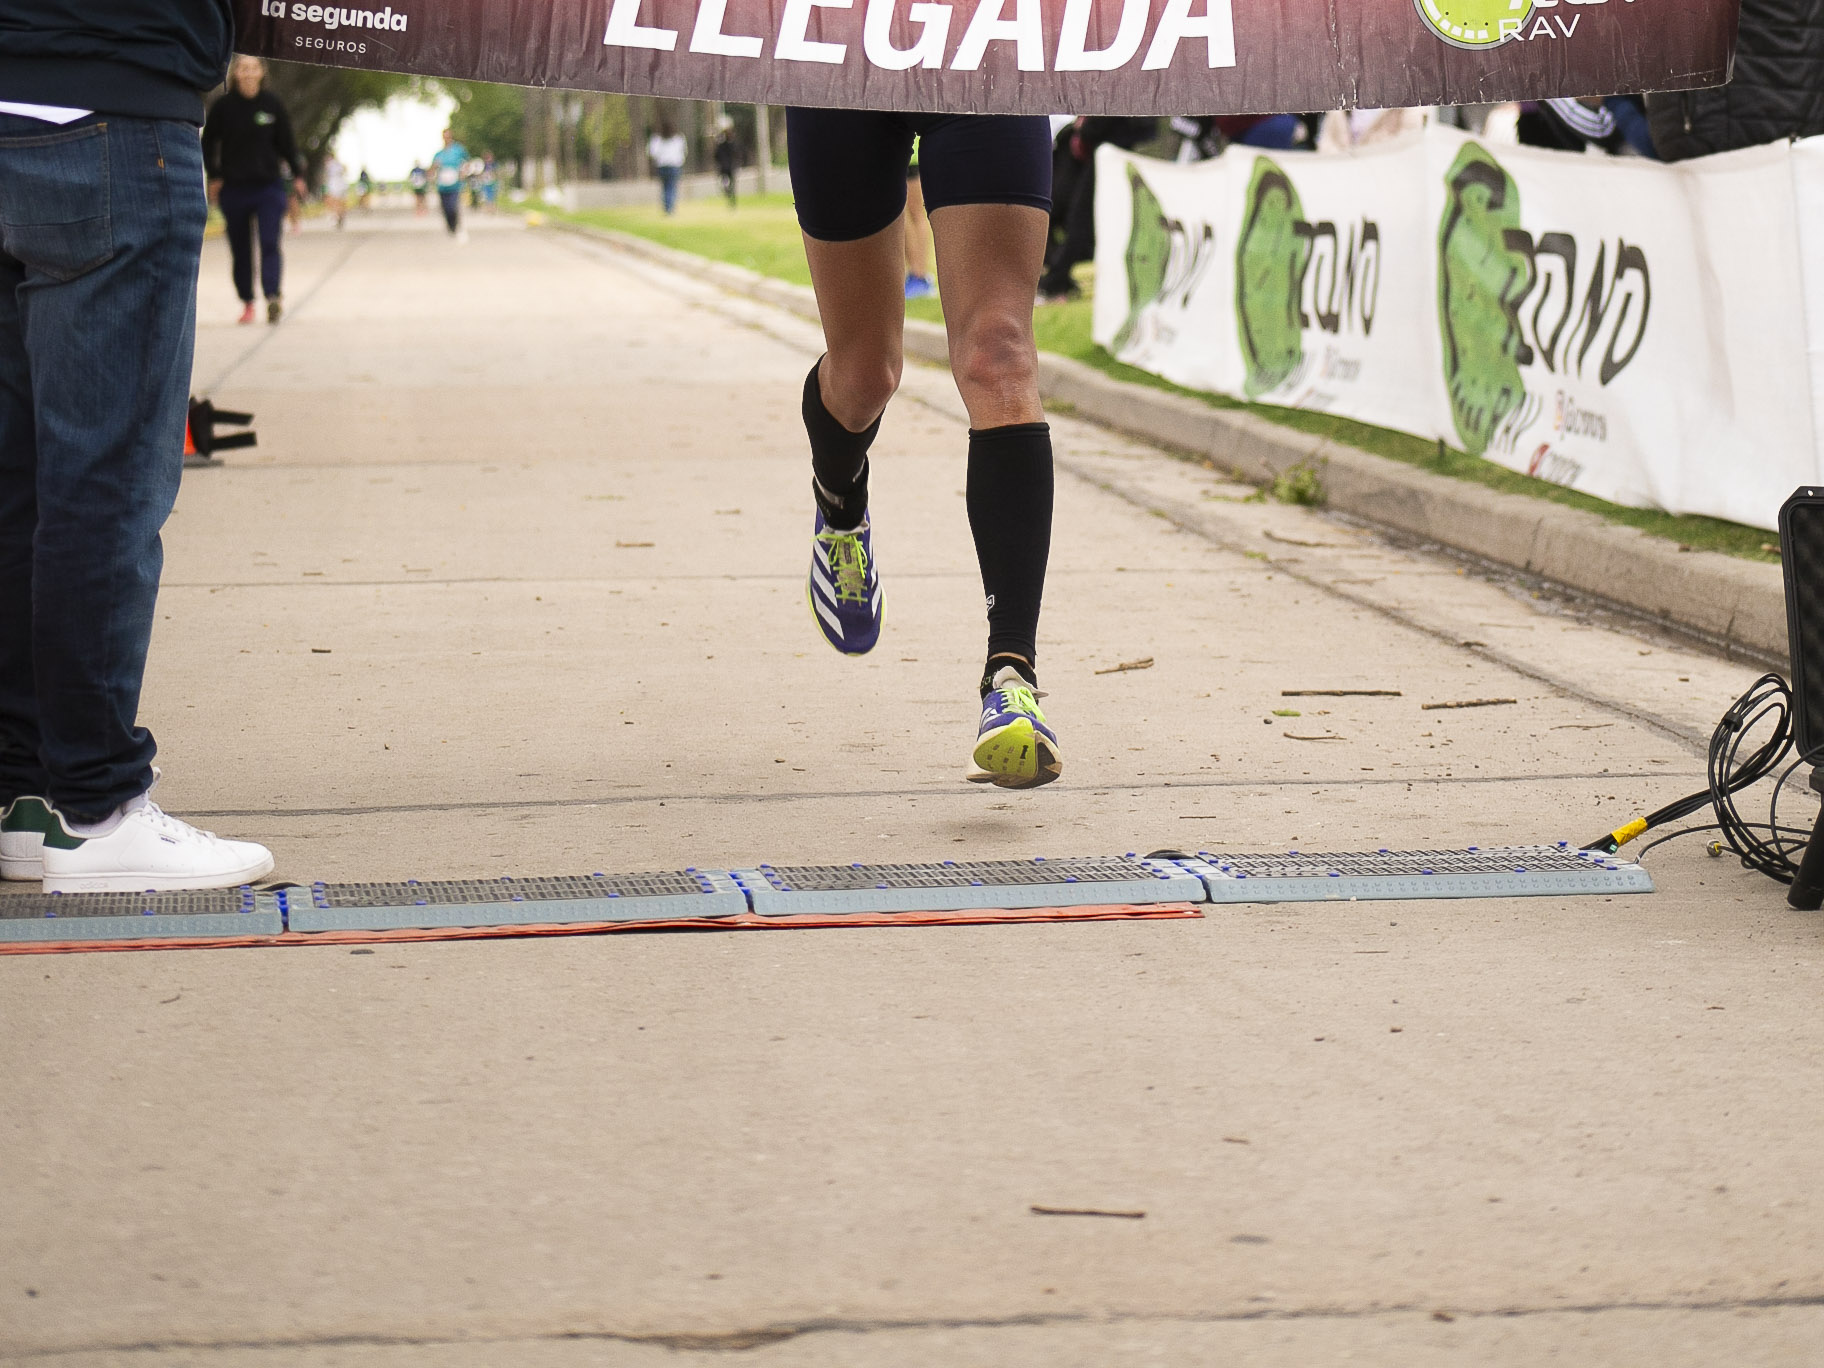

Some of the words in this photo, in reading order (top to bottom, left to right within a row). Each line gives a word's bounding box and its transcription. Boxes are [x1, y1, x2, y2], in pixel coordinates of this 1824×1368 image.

[292, 1, 408, 33] segunda
[1498, 13, 1581, 43] RAV
[295, 36, 367, 54] SEGUROS
